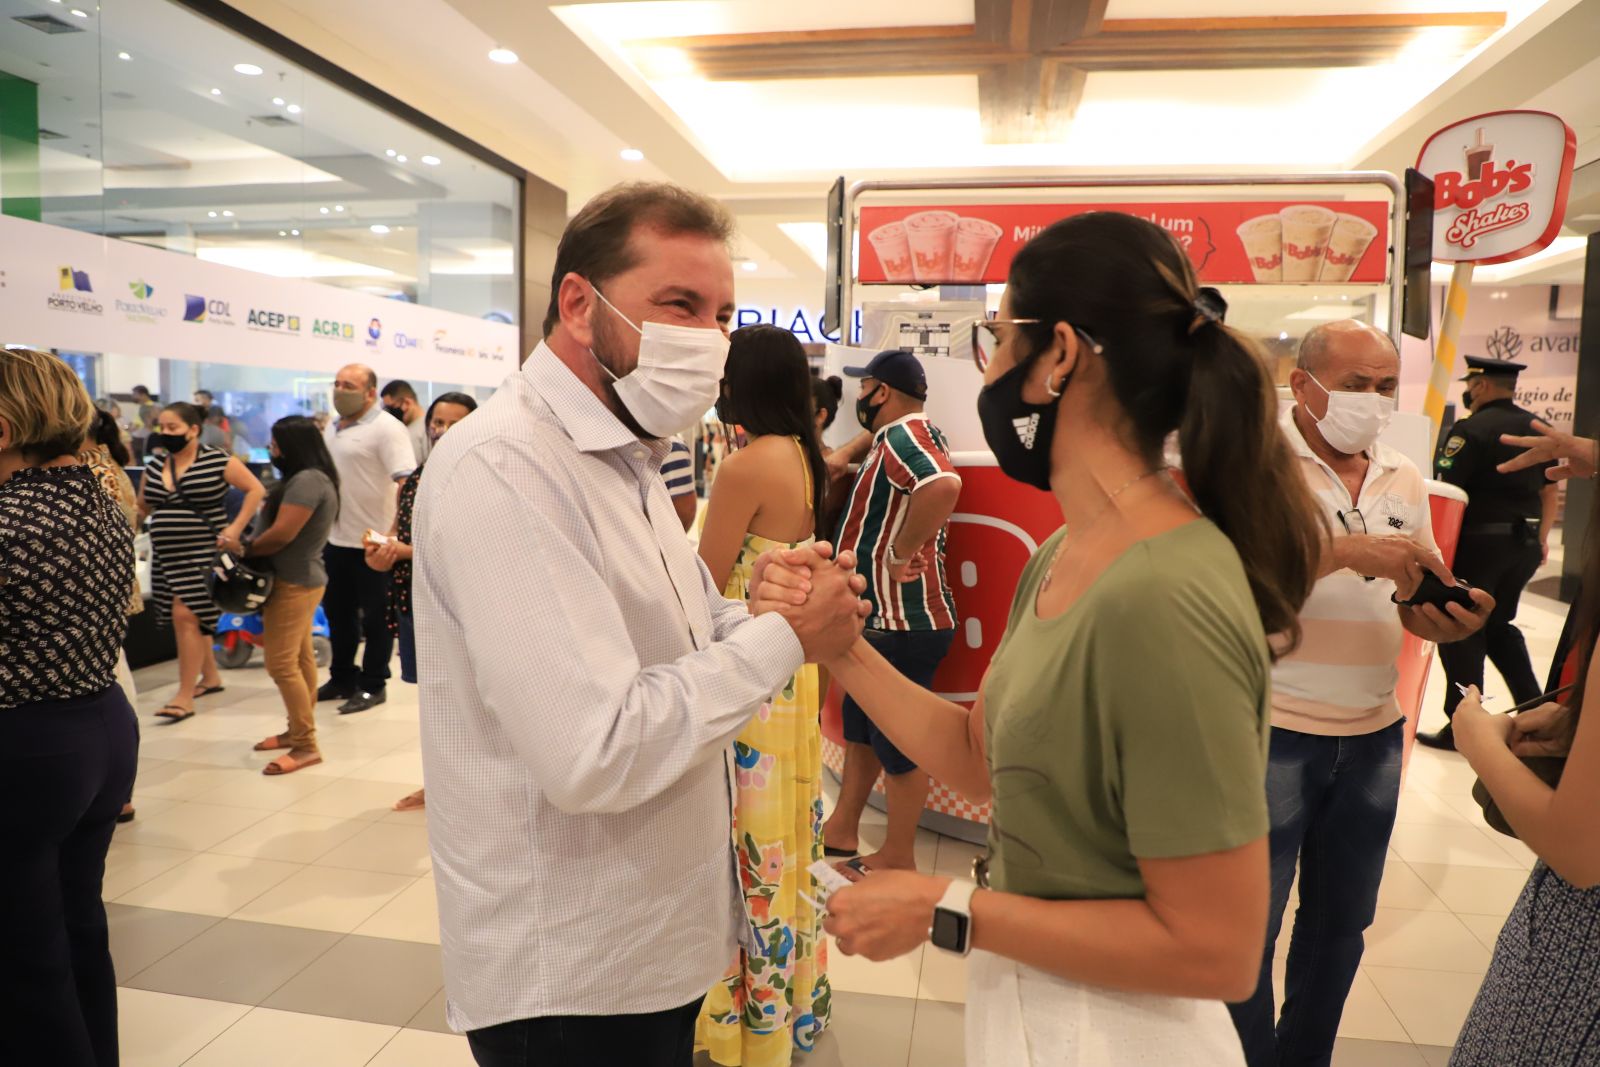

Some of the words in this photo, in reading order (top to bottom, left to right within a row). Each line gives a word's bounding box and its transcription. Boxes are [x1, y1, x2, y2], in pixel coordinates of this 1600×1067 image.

[1434, 160, 1532, 210] Bob's
[1446, 202, 1529, 248] Shakes
[1013, 226, 1045, 242] Mil
[48, 298, 76, 310] PORTO
[78, 302, 103, 313] VELHO
[208, 299, 231, 317] CDL
[248, 309, 285, 329] ACEP
[313, 319, 340, 336] ACR
[1553, 387, 1573, 402] de
